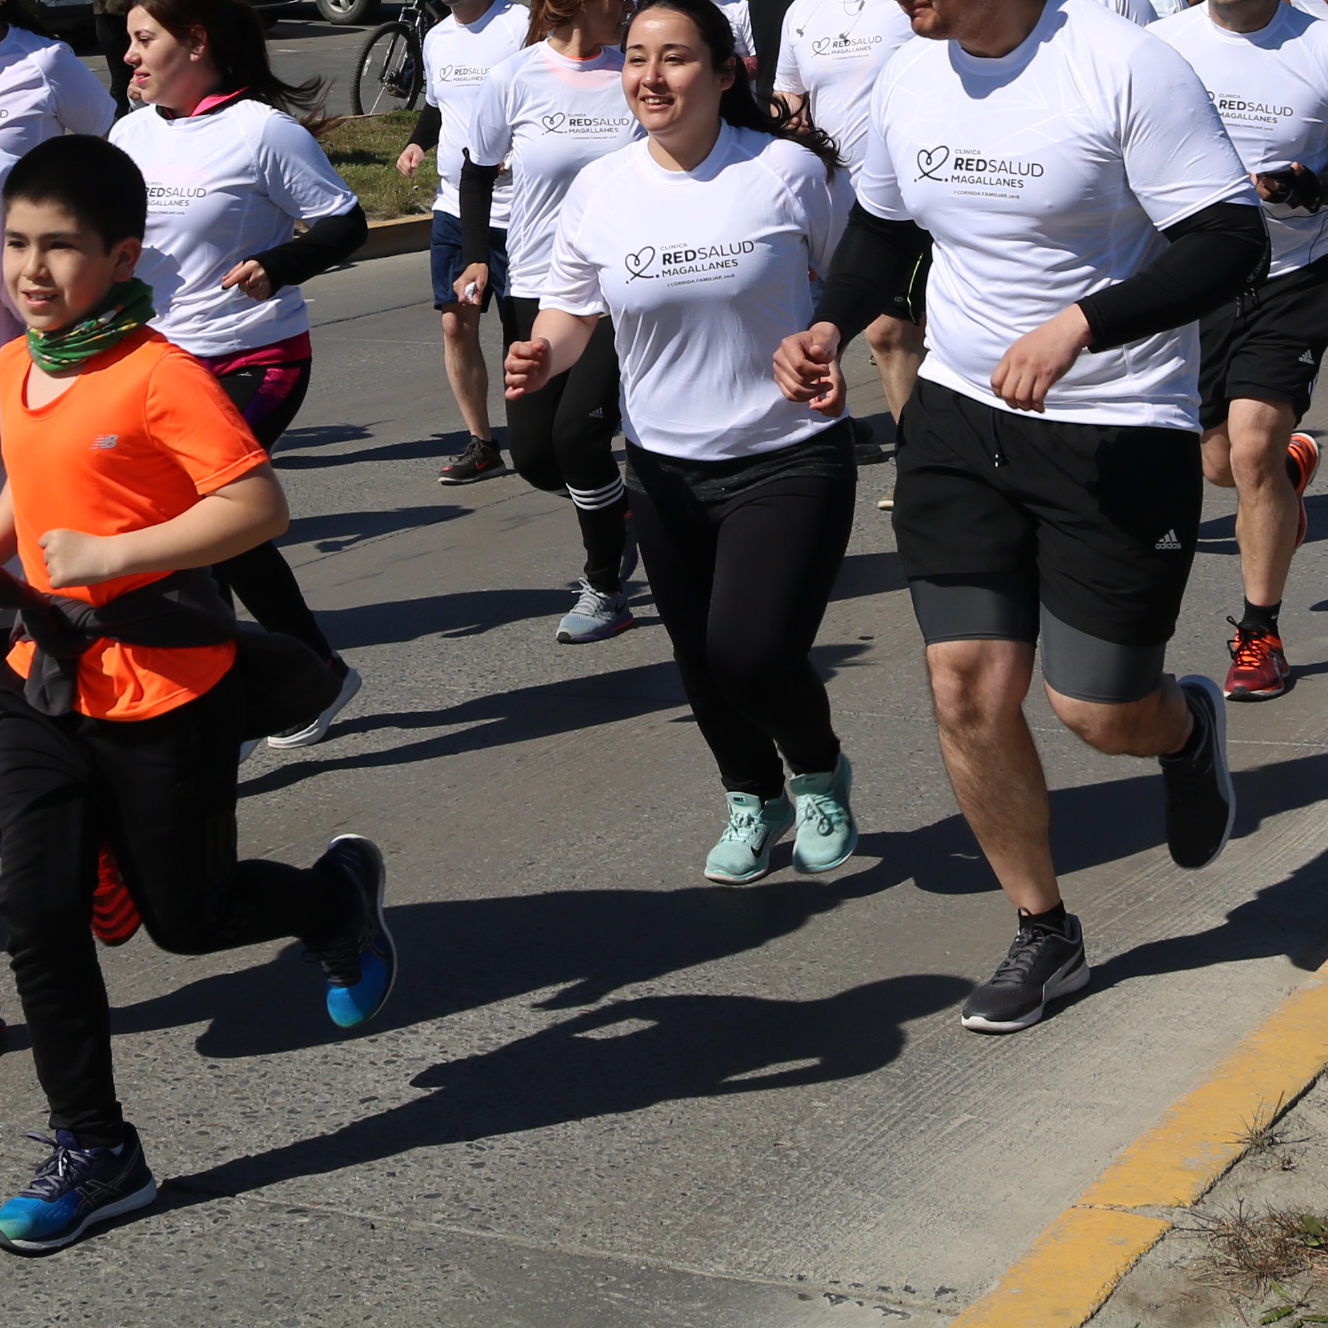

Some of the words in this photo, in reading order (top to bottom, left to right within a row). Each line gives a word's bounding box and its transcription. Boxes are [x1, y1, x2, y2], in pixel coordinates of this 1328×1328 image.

[1218, 99, 1294, 117] REDSALUD
[569, 118, 630, 126] REDSALUD
[953, 157, 1044, 178] REDSALUD
[951, 174, 1024, 189] MAGALLANES
[982, 191, 1008, 199] FAMILIAR
[146, 199, 190, 207] AGALLANES
[660, 243, 688, 251] CLINICA
[662, 240, 755, 266] REDSALUD
[662, 259, 739, 277] MAGALLANES
[670, 279, 695, 287] CORRIDA
[696, 275, 723, 283] FAMILIAR
[1155, 542, 1181, 550] adidas
